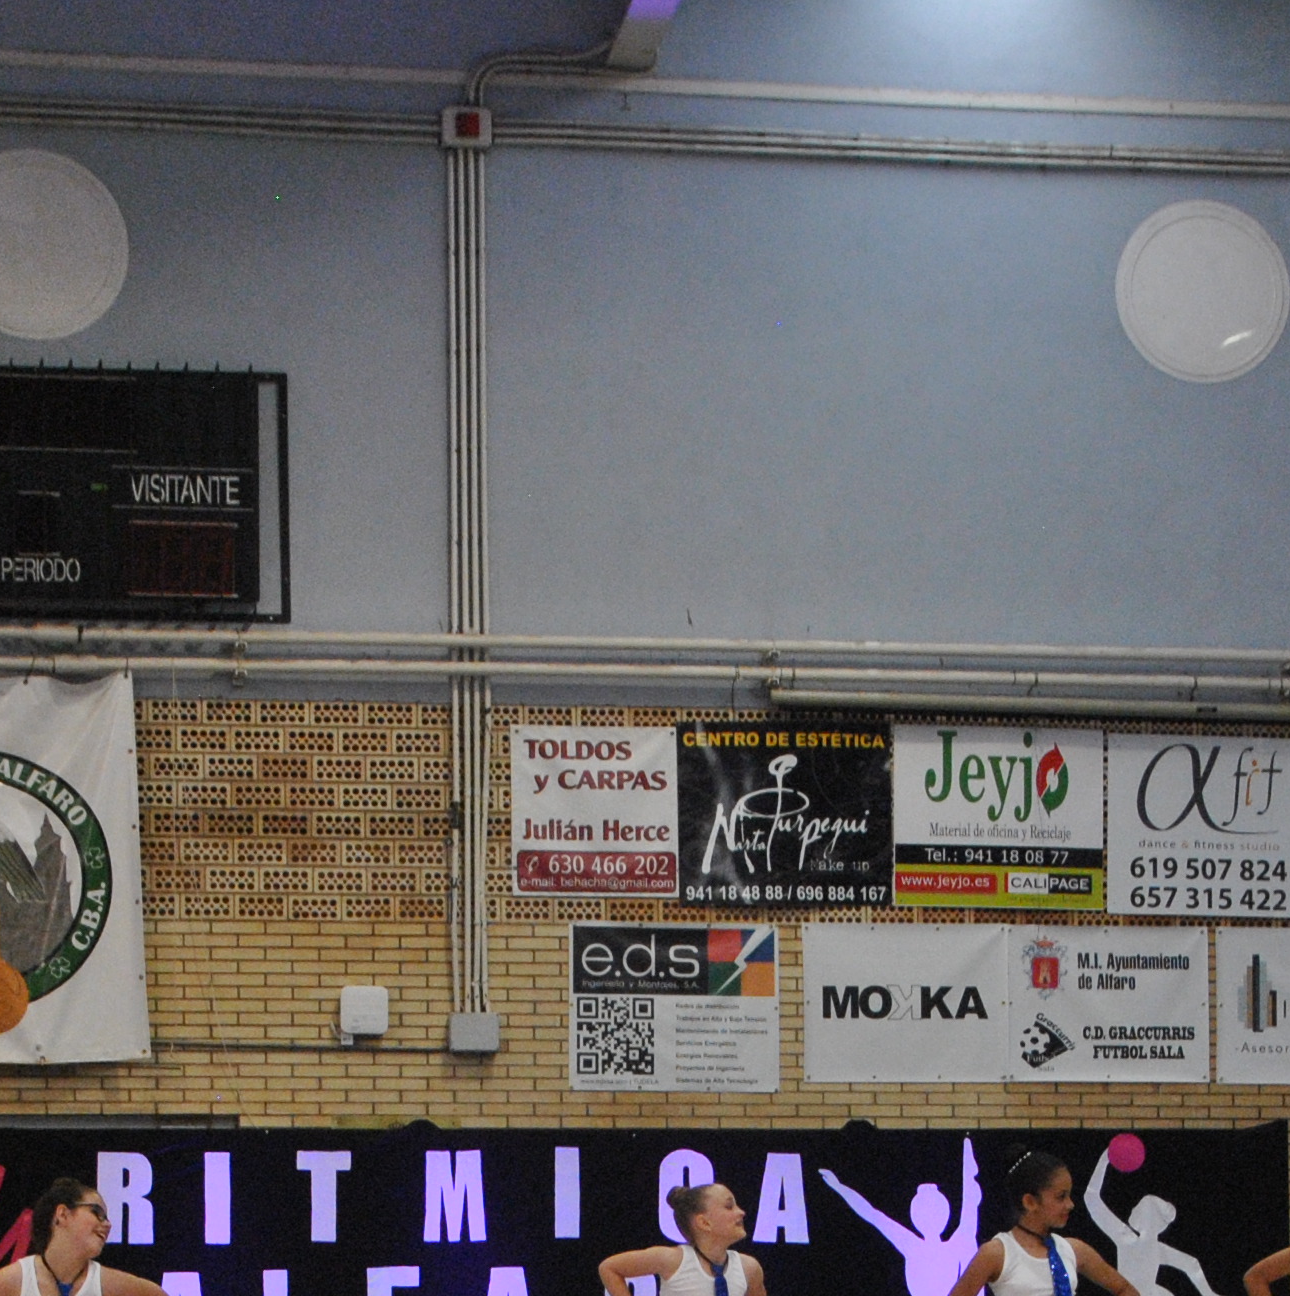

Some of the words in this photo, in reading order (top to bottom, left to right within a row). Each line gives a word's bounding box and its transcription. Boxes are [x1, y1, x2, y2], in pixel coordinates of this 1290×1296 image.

[131, 473, 241, 506] VISITANTE
[0, 556, 81, 583] PERIODO
[682, 731, 759, 748] CENTRO
[766, 732, 789, 748] DE
[795, 729, 885, 749] ESTÉTICA
[523, 739, 633, 761] TOLDOS
[533, 774, 549, 794] y
[558, 769, 668, 791] CARPAS
[924, 729, 1069, 822] Jeyjo
[522, 817, 594, 841] Julián
[601, 819, 671, 841] Herce
[929, 822, 971, 838] Material
[973, 823, 984, 838] de
[987, 824, 1019, 839] oficina
[1021, 827, 1027, 841] y
[1030, 825, 1072, 843] Reciclaje
[1138, 840, 1176, 849] dance
[1194, 840, 1235, 850] fitness
[1239, 841, 1281, 851] studio
[548, 854, 584, 875] 630
[591, 855, 627, 875] 466
[634, 855, 669, 875] 202
[852, 861, 870, 873] up
[924, 848, 958, 863] Tel.:
[964, 849, 994, 864] 941
[1001, 849, 1019, 864] 18
[1025, 850, 1044, 865] 08
[1051, 851, 1069, 865] 77
[1130, 856, 1178, 879] 619
[1186, 858, 1232, 880] 507
[1239, 859, 1288, 882] 824
[686, 885, 713, 900] 941
[719, 885, 737, 900] 18
[742, 885, 760, 900] 48
[765, 885, 783, 900] 88
[797, 885, 823, 901] 696
[828, 886, 855, 901] 884
[860, 886, 886, 901] 167
[901, 874, 990, 889] www.jeyjo.es
[1010, 876, 1090, 891] CALIPAGE
[1130, 886, 1178, 908] 657
[1186, 887, 1232, 909] 315
[1239, 889, 1287, 911] 422
[71, 881, 107, 951] C.B.A.
[581, 934, 701, 979] e.d.s
[1078, 953, 1103, 969] M.I.
[1107, 952, 1190, 973] Ayuntamiento
[1078, 975, 1094, 990] de
[1096, 975, 1136, 991] Alfaro
[1036, 1012, 1075, 1051] Graccurris
[1083, 1026, 1106, 1040] C.D.
[1109, 1026, 1195, 1041] GRACCURRIS
[1093, 1045, 1148, 1059] FUTBOL
[1150, 1045, 1185, 1060] SALA
